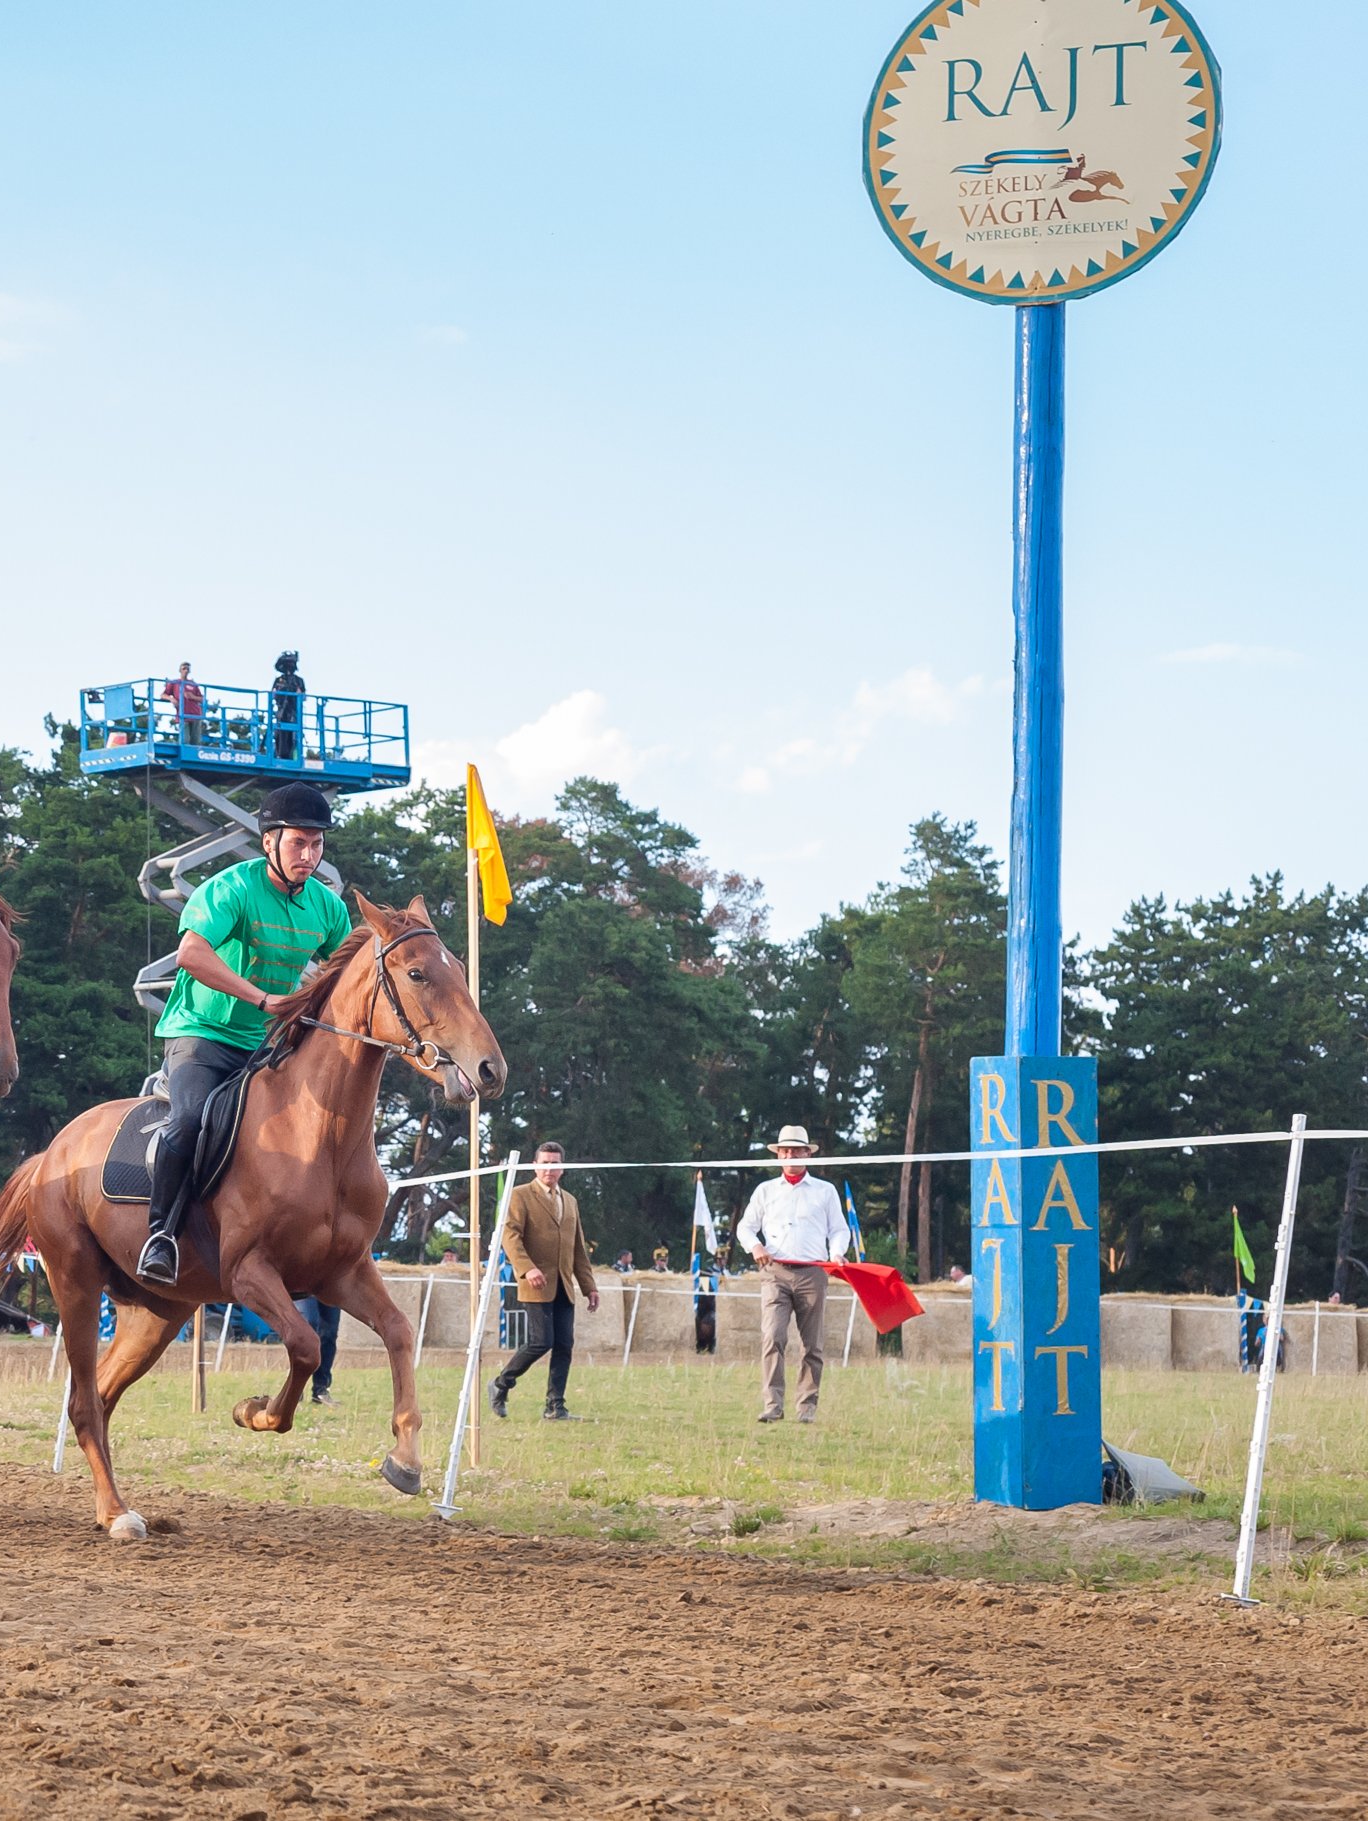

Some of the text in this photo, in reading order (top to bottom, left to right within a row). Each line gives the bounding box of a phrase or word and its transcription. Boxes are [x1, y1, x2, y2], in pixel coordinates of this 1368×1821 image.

[941, 40, 1148, 132] RAJT
[957, 196, 1069, 228] VÁGTA
[958, 173, 1048, 198] SZÉKELY
[965, 218, 1129, 243] NYEREGBE, SZÉKELYEK!
[977, 1073, 1019, 1412] RAJT
[1029, 1079, 1093, 1416] RAJT
